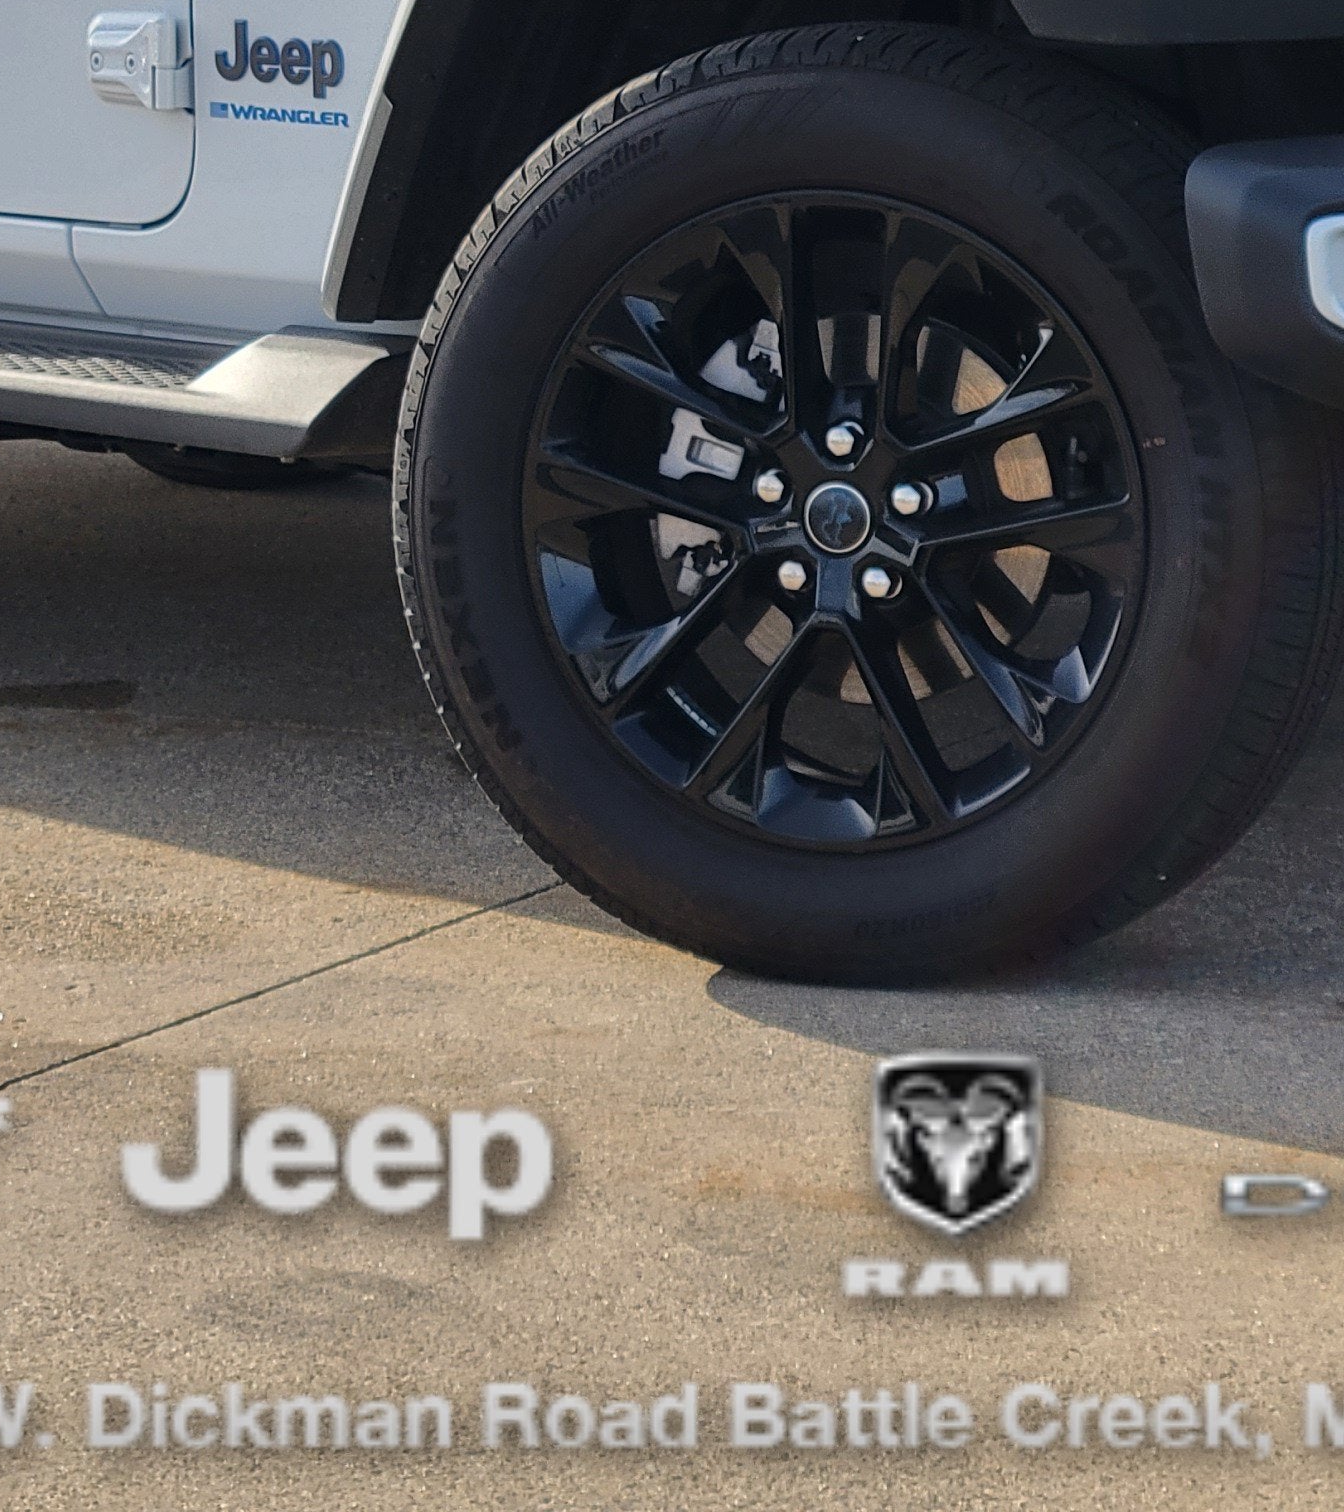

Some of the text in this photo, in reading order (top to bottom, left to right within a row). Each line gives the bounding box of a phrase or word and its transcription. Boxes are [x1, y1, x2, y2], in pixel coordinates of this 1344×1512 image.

[214, 19, 345, 99] Jeep
[230, 102, 350, 128] WRANGLER
[529, 128, 667, 242] All-Weather
